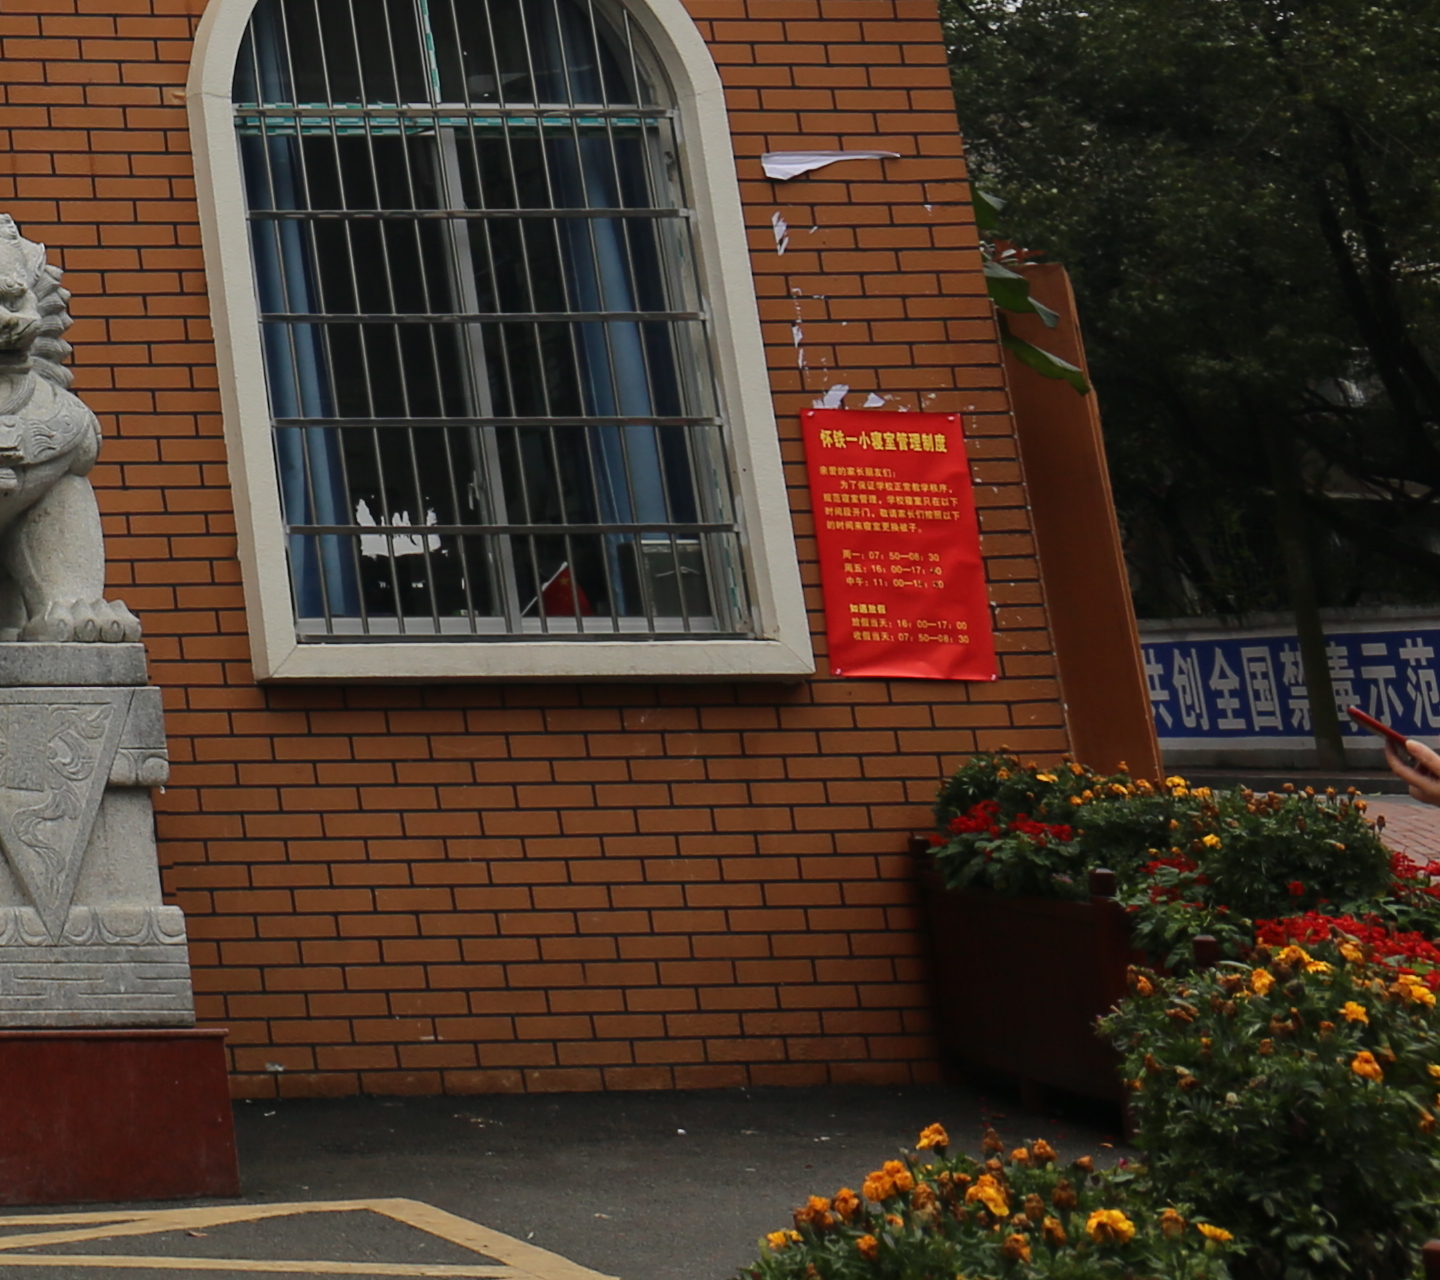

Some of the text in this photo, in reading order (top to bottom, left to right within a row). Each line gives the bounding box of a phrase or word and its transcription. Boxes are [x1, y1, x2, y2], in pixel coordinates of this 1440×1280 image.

[820, 429, 948, 453] 怀铁一小寝室管理制度
